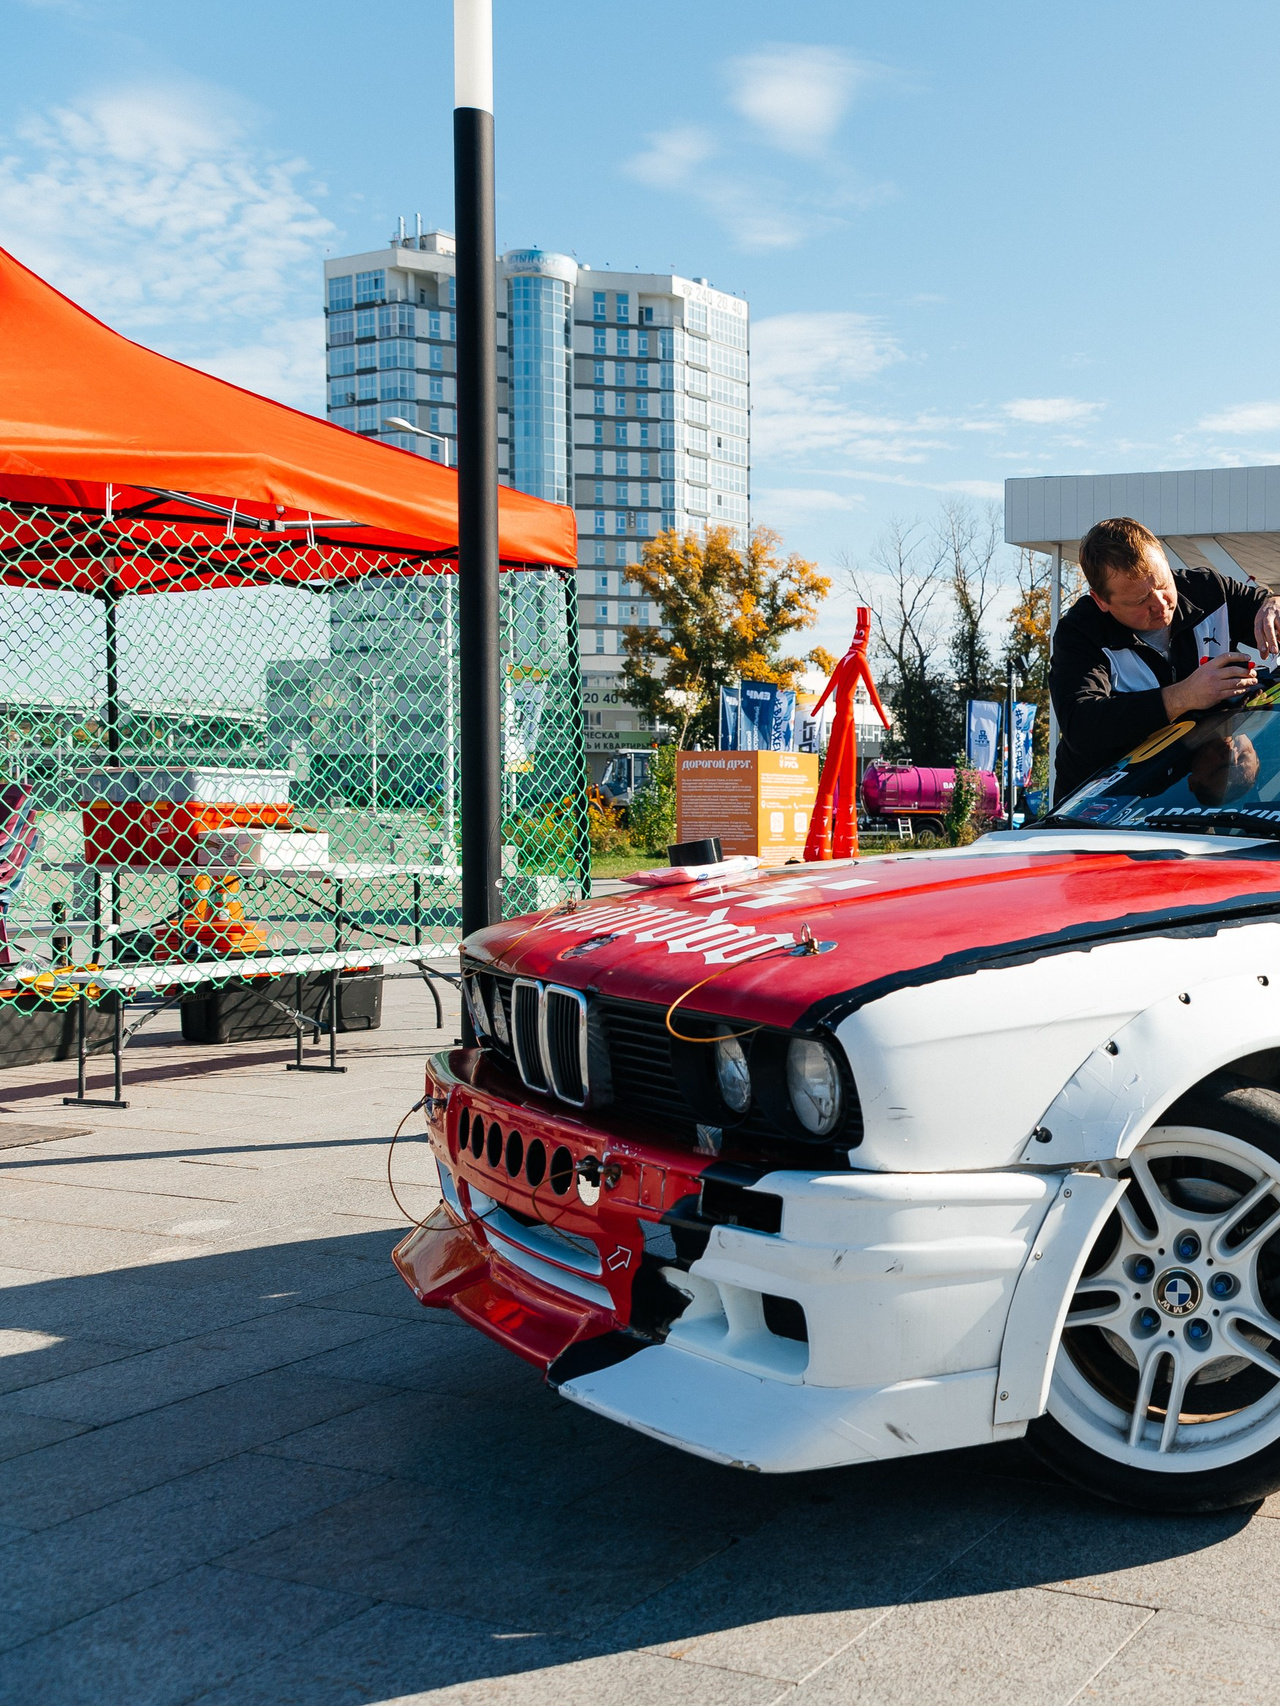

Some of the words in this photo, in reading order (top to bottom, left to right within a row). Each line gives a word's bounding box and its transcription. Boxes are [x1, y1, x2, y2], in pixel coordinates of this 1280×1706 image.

[717, 294, 728, 309] 20
[732, 300, 743, 315] 40
[583, 692, 599, 704] 20
[602, 693, 619, 704] 40
[681, 757, 726, 771] ДОРОГОЙ
[1161, 1300, 1194, 1313] BMW
